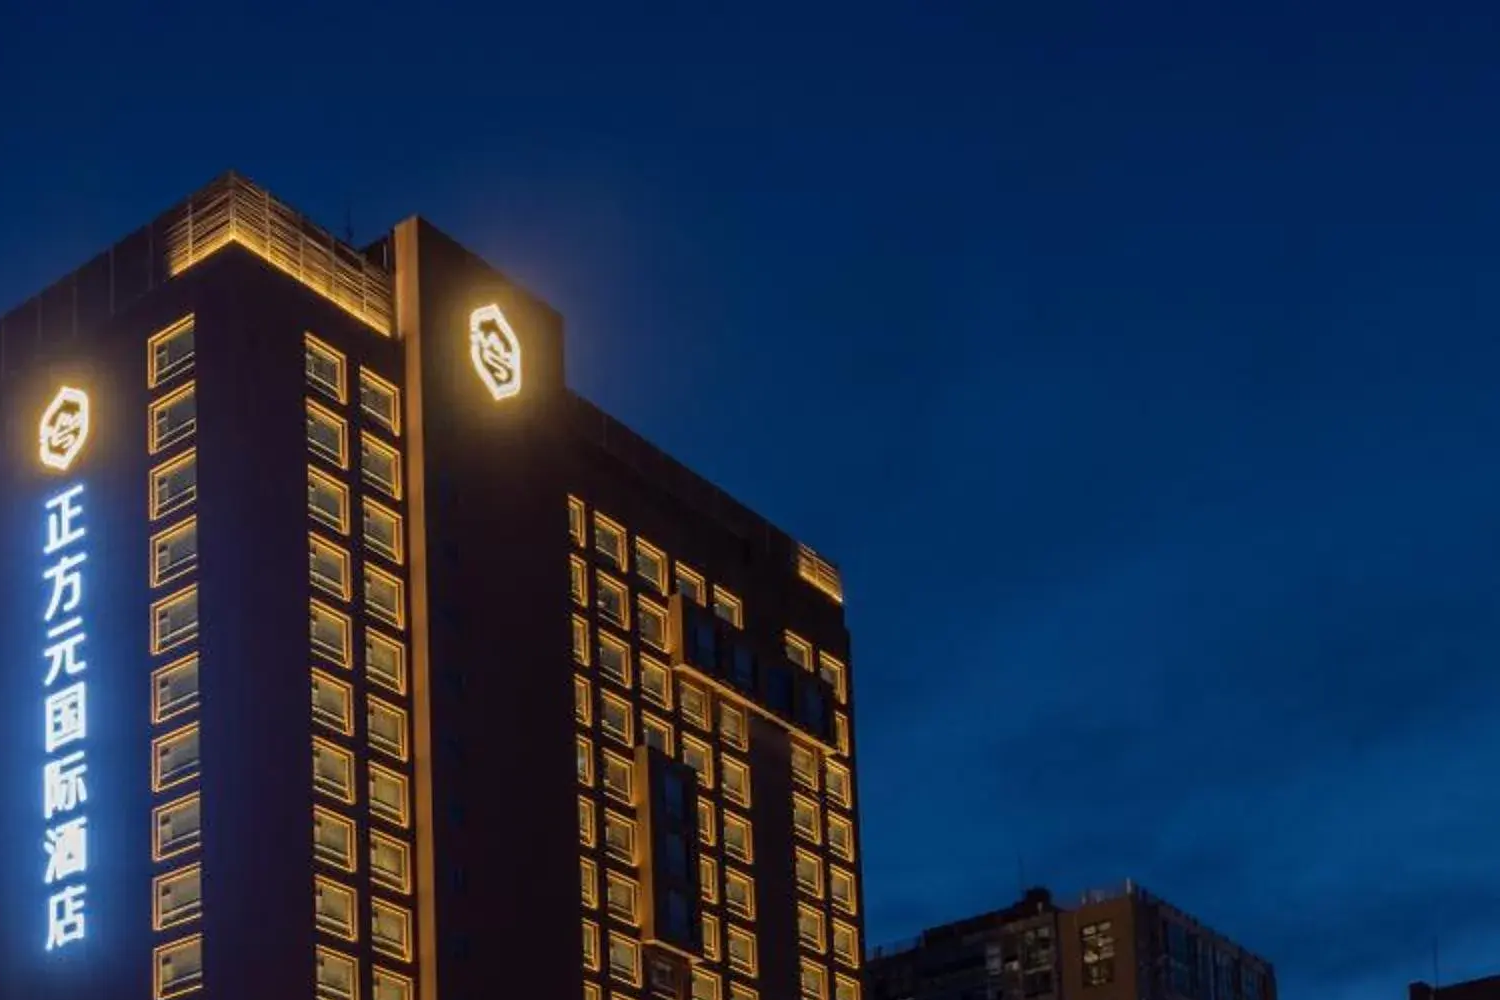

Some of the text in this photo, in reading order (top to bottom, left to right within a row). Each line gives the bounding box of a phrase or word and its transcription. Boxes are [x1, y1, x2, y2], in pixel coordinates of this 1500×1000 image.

[43, 484, 88, 952] 正方元国际酒店
